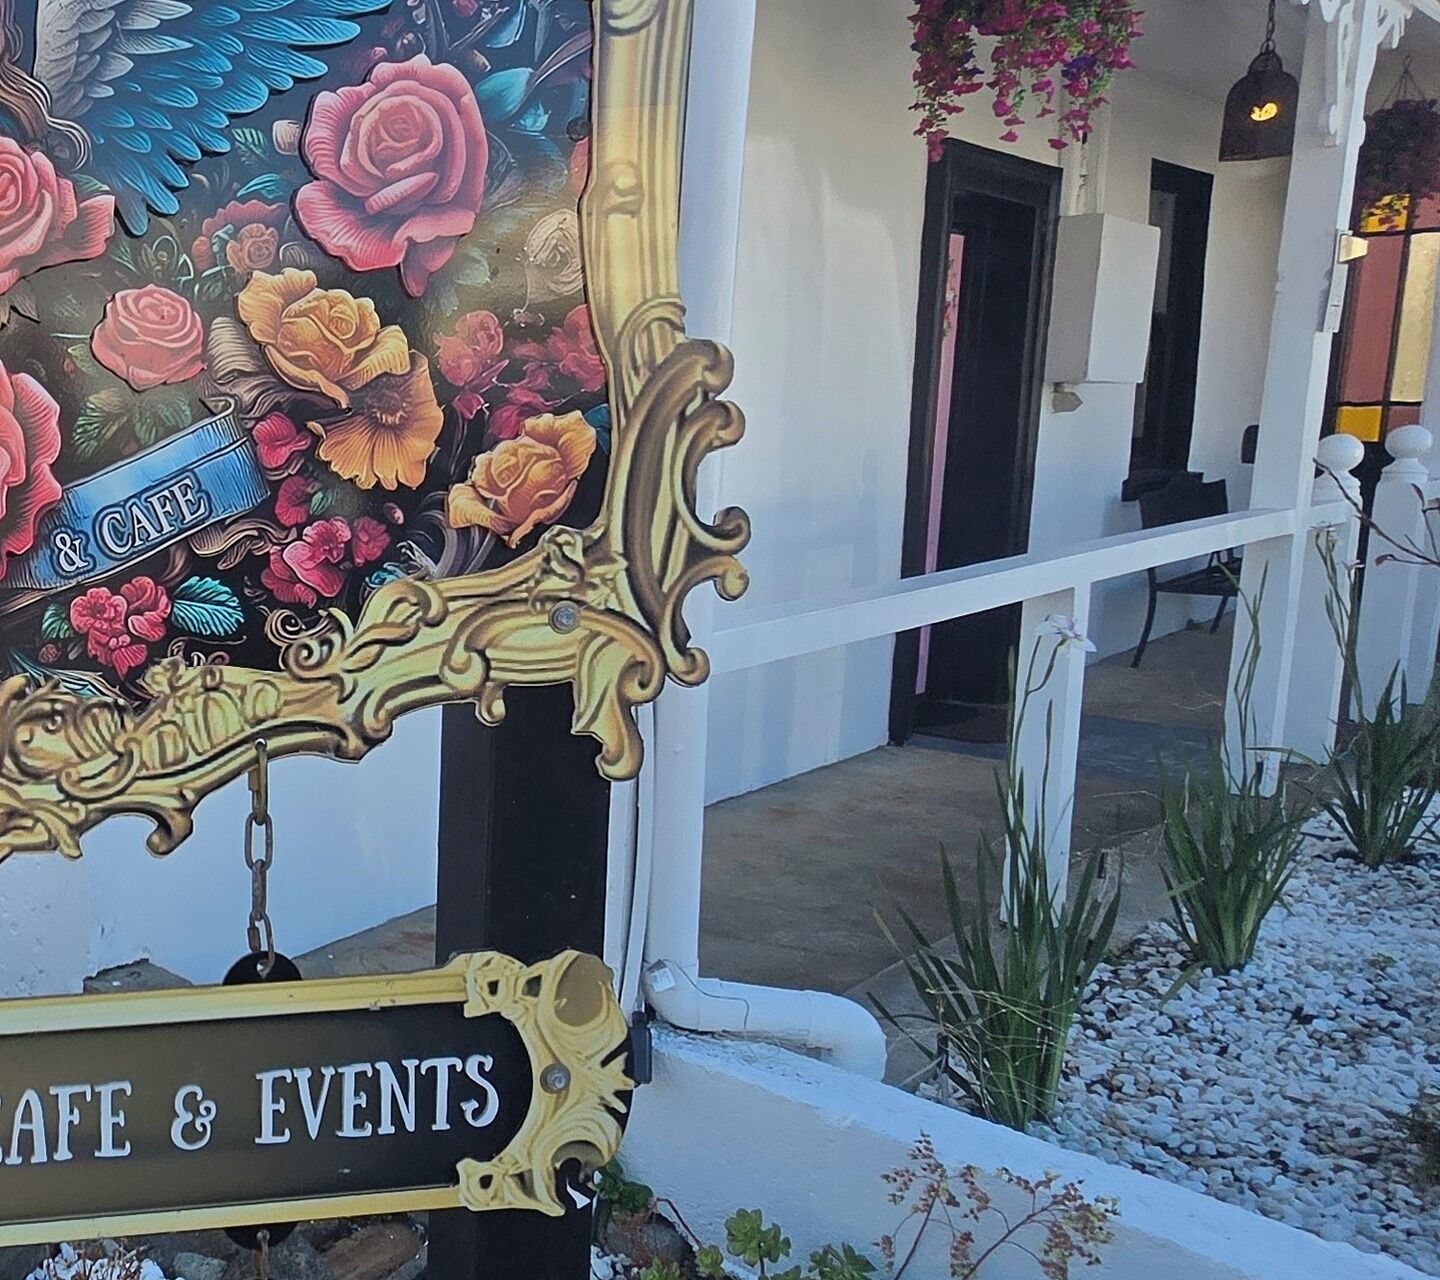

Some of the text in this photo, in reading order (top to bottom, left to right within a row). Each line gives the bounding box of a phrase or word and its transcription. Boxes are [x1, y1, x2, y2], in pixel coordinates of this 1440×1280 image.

[55, 477, 206, 573] & CAFE
[170, 1084, 217, 1151] &
[254, 1053, 501, 1145] EVENTS
